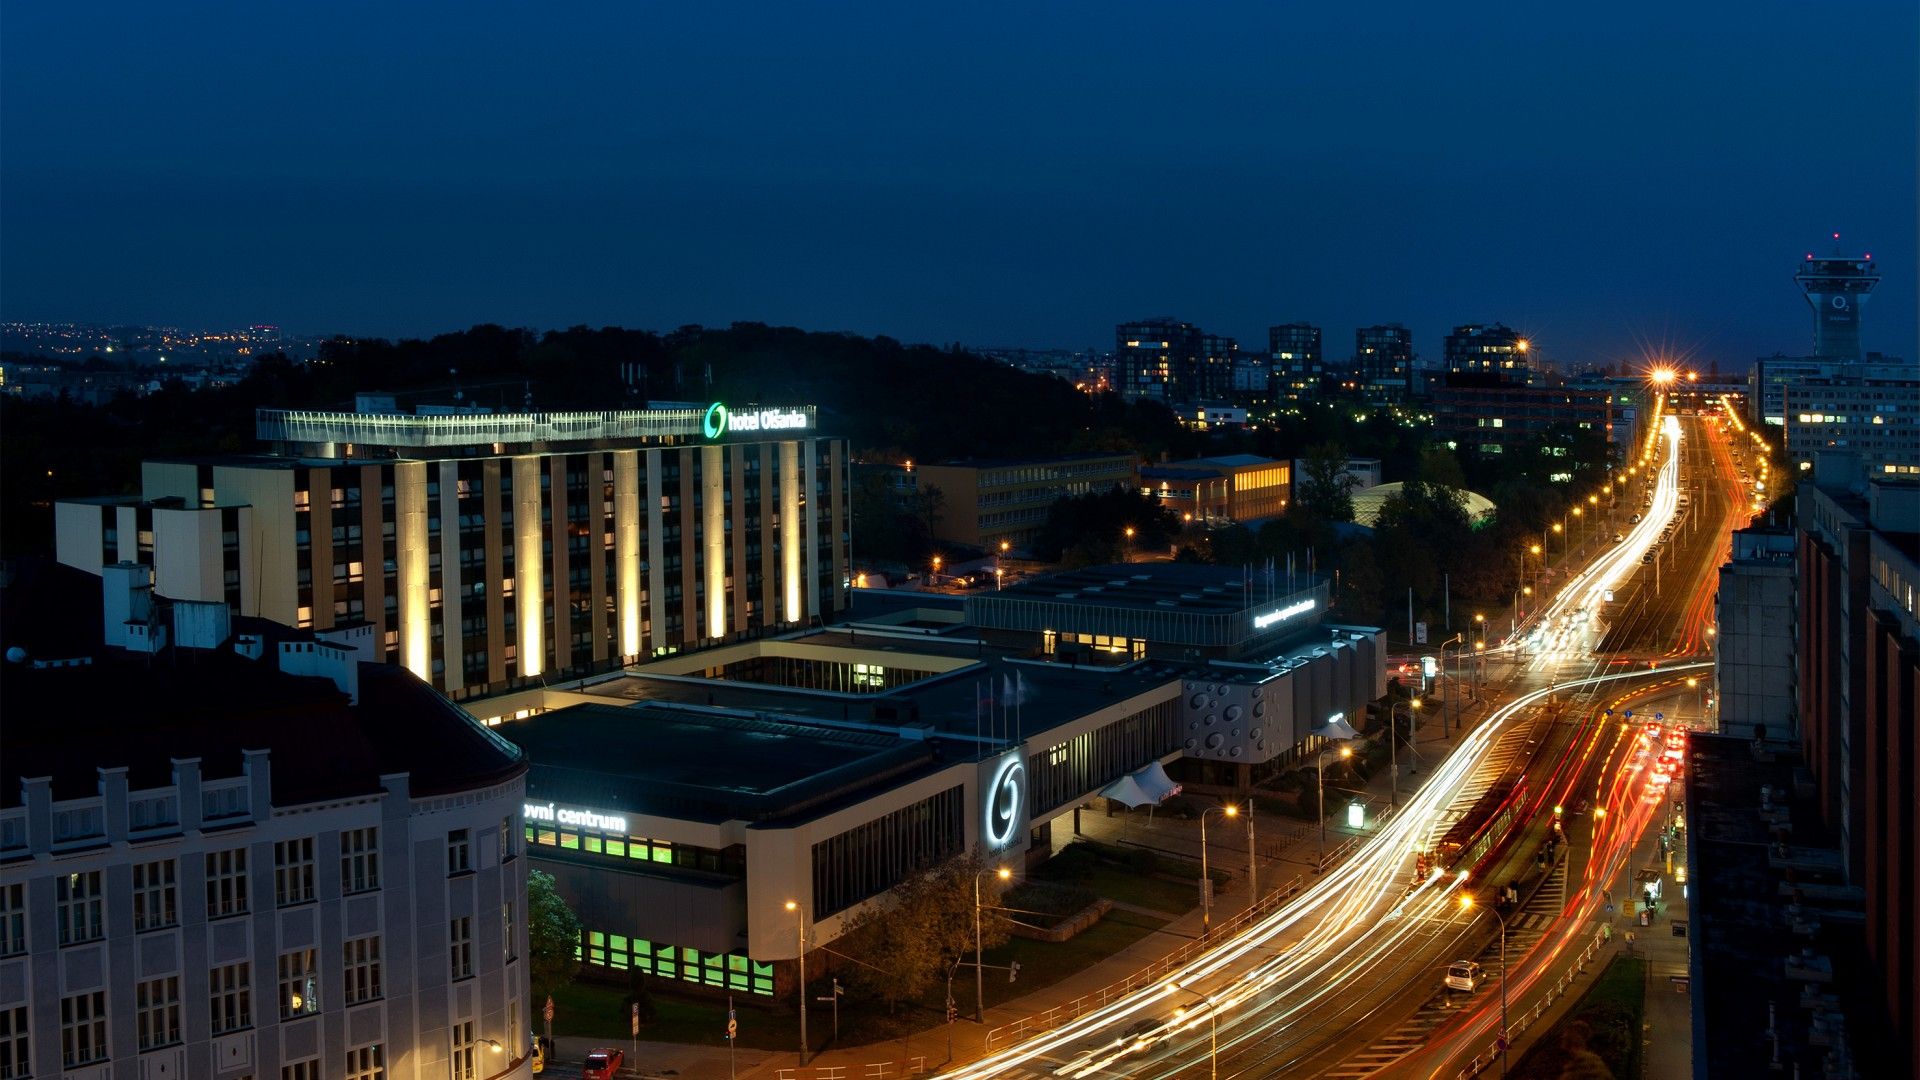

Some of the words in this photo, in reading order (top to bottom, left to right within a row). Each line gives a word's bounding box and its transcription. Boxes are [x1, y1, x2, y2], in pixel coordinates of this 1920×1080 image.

[1831, 295, 1850, 312] O2
[728, 411, 759, 430] hotel
[761, 409, 806, 430] Olšanka
[557, 809, 626, 832] centrum
